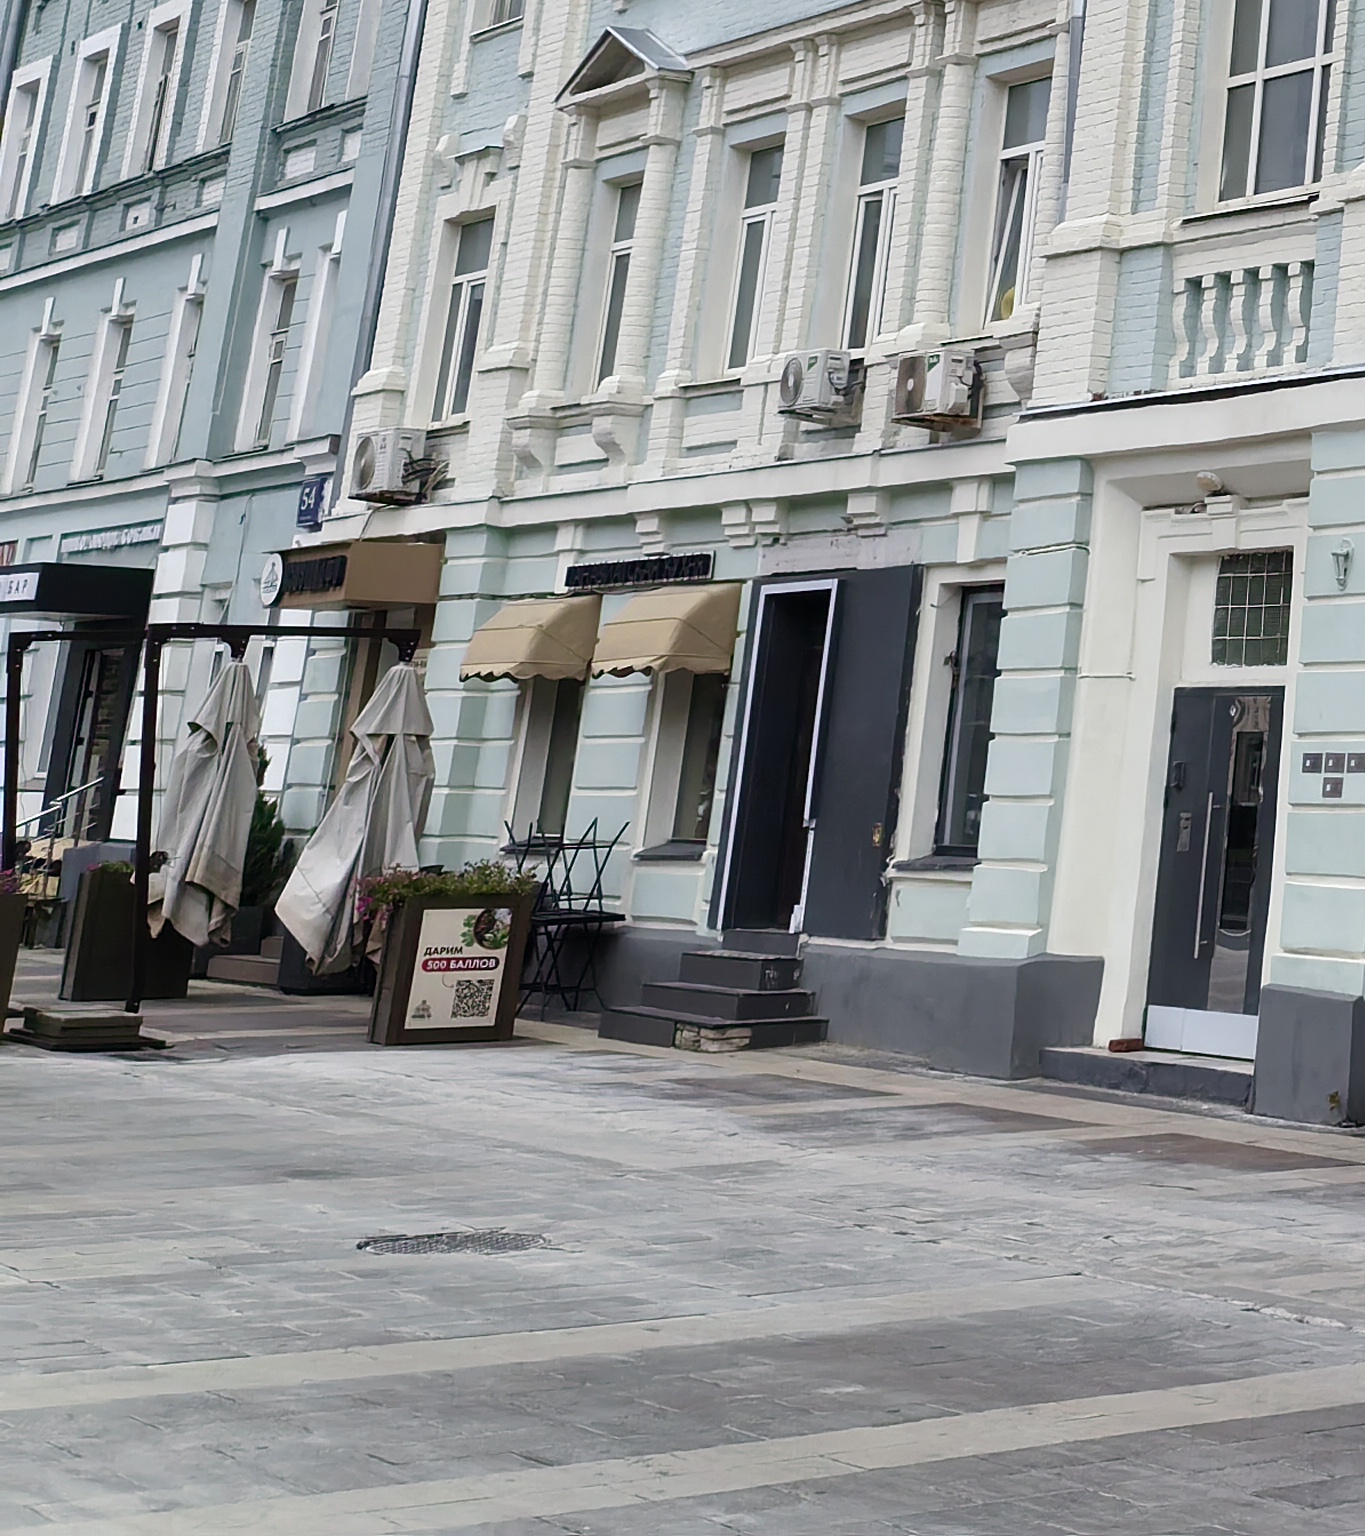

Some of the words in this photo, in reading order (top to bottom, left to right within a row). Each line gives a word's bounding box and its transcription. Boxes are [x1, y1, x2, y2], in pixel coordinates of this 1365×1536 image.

[301, 486, 317, 510] 54
[424, 946, 463, 957] ДАРИМ
[426, 960, 447, 970] 500
[449, 959, 496, 969] БАЛЛОВ
